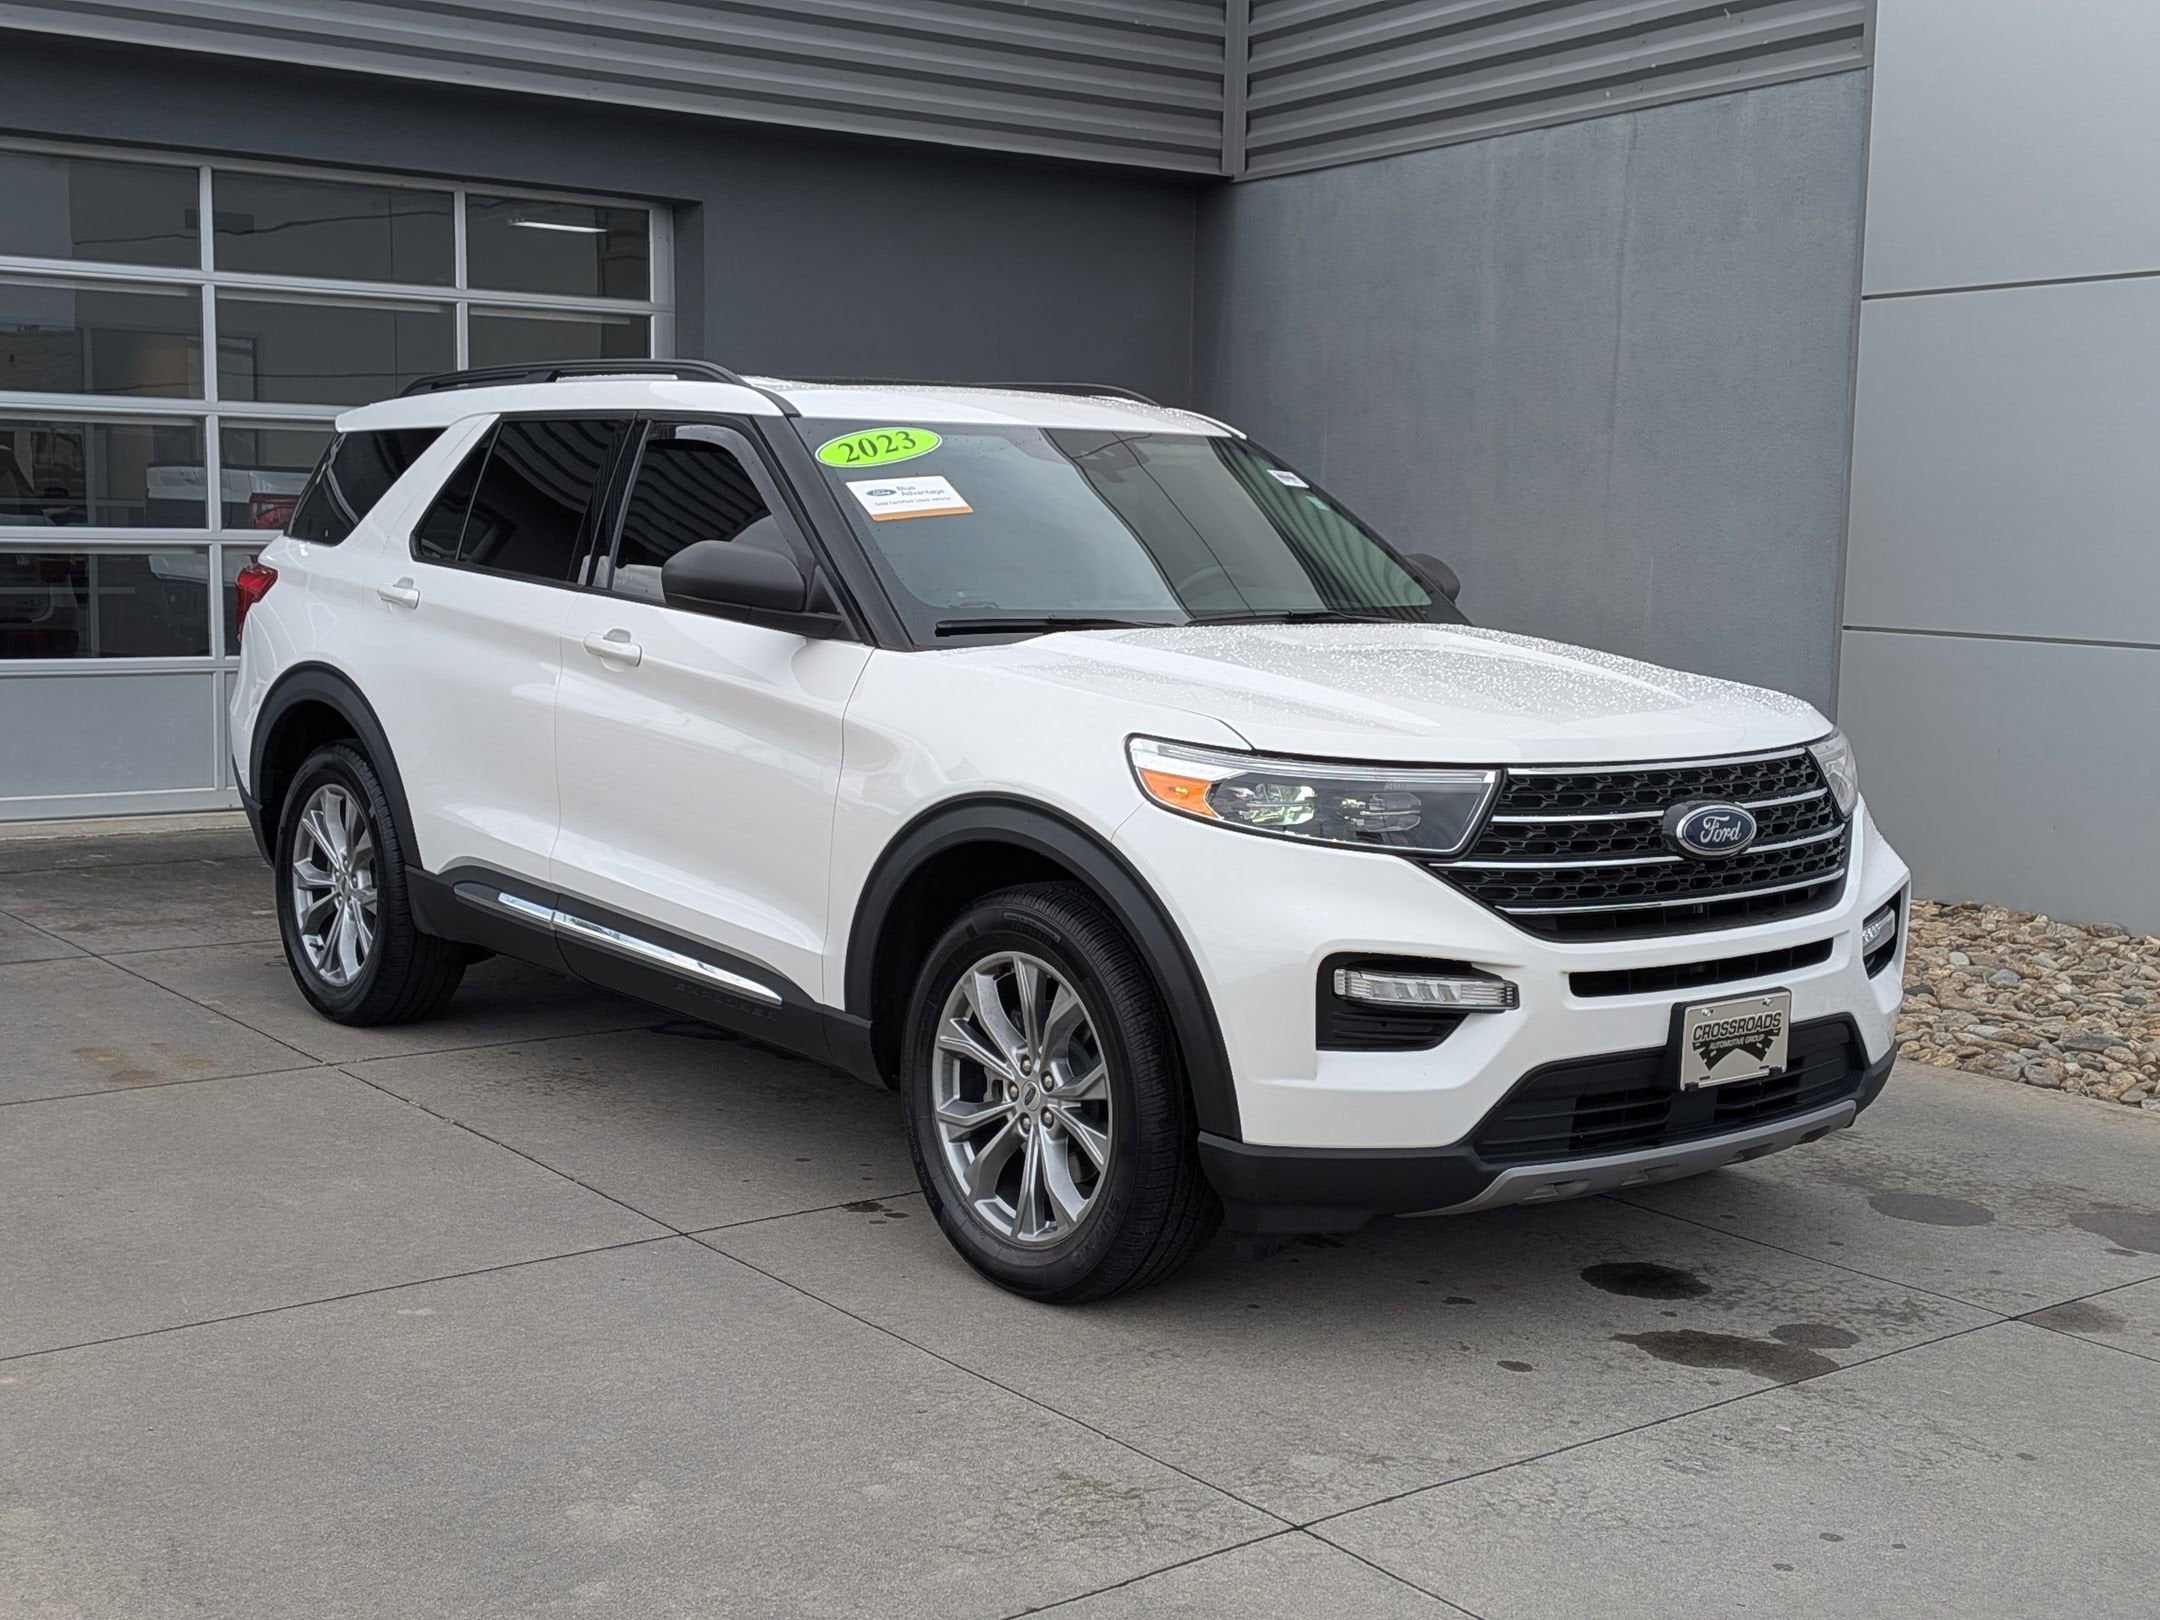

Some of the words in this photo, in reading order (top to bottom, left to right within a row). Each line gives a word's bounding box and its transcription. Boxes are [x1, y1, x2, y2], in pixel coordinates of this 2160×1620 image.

[837, 431, 916, 463] 2023
[1700, 815, 1741, 843] Ford
[1693, 1011, 1782, 1042] CROSSROADS
